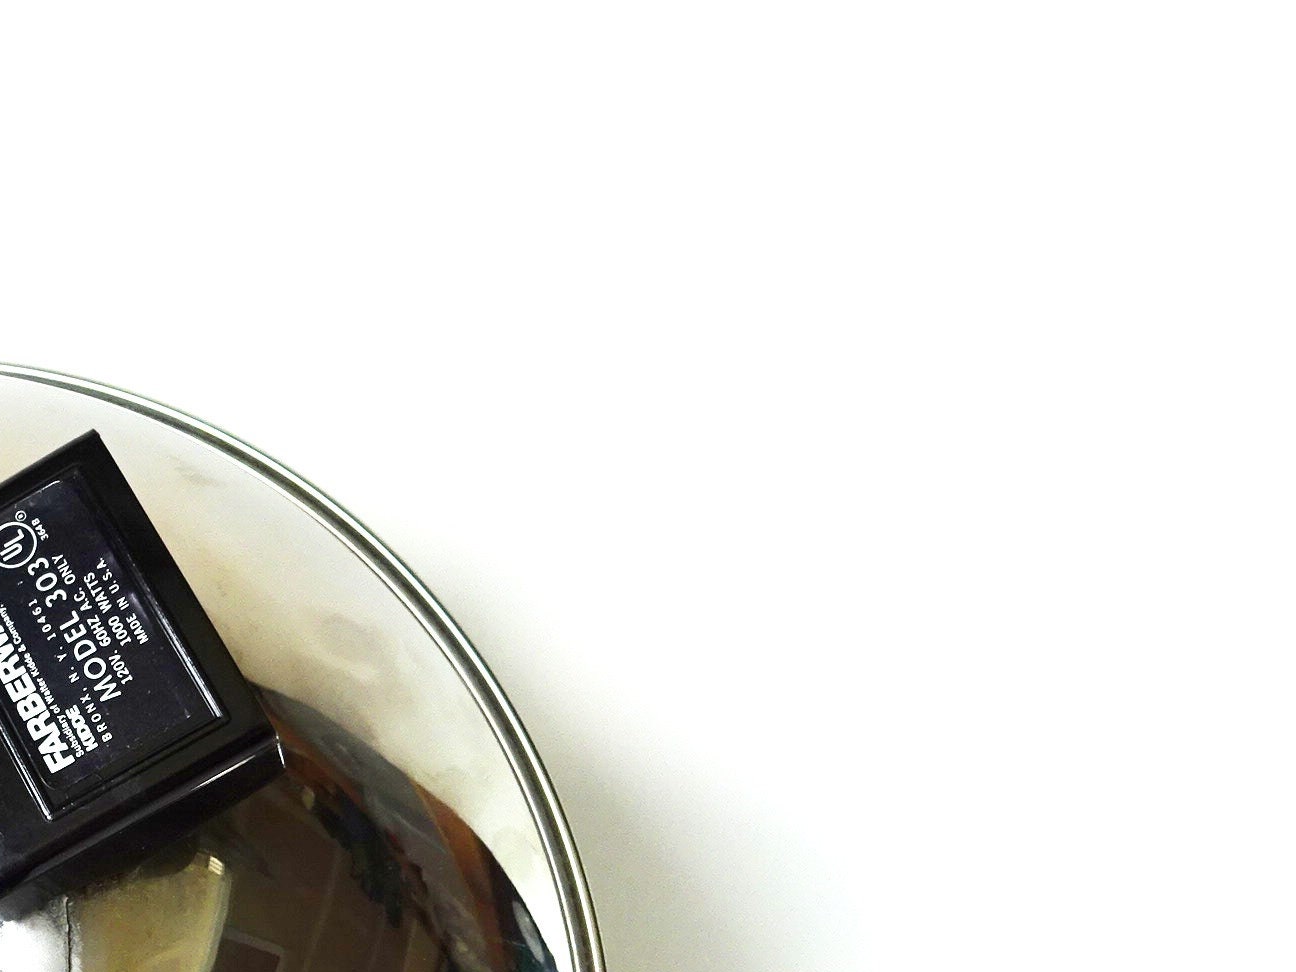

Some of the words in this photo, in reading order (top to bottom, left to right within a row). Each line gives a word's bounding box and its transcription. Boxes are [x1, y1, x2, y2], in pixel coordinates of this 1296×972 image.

[31, 518, 49, 541] 364B
[27, 557, 67, 608] 303
[51, 554, 76, 585] ONLY
[84, 572, 112, 614] WATTS
[116, 596, 130, 611] IN
[0, 604, 22, 645] Company,
[28, 599, 57, 641] 10461
[86, 614, 111, 647] 60HZ
[108, 615, 132, 647] 1000
[125, 612, 149, 645] MADE
[18, 644, 26, 652] &
[59, 610, 122, 702] MODEL
[24, 652, 40, 678] Kidde
[108, 649, 134, 685] 120V.
[36, 678, 54, 705] Walter
[49, 704, 60, 714] of
[57, 715, 84, 758] Subsidiary
[65, 704, 99, 752] KIDDE
